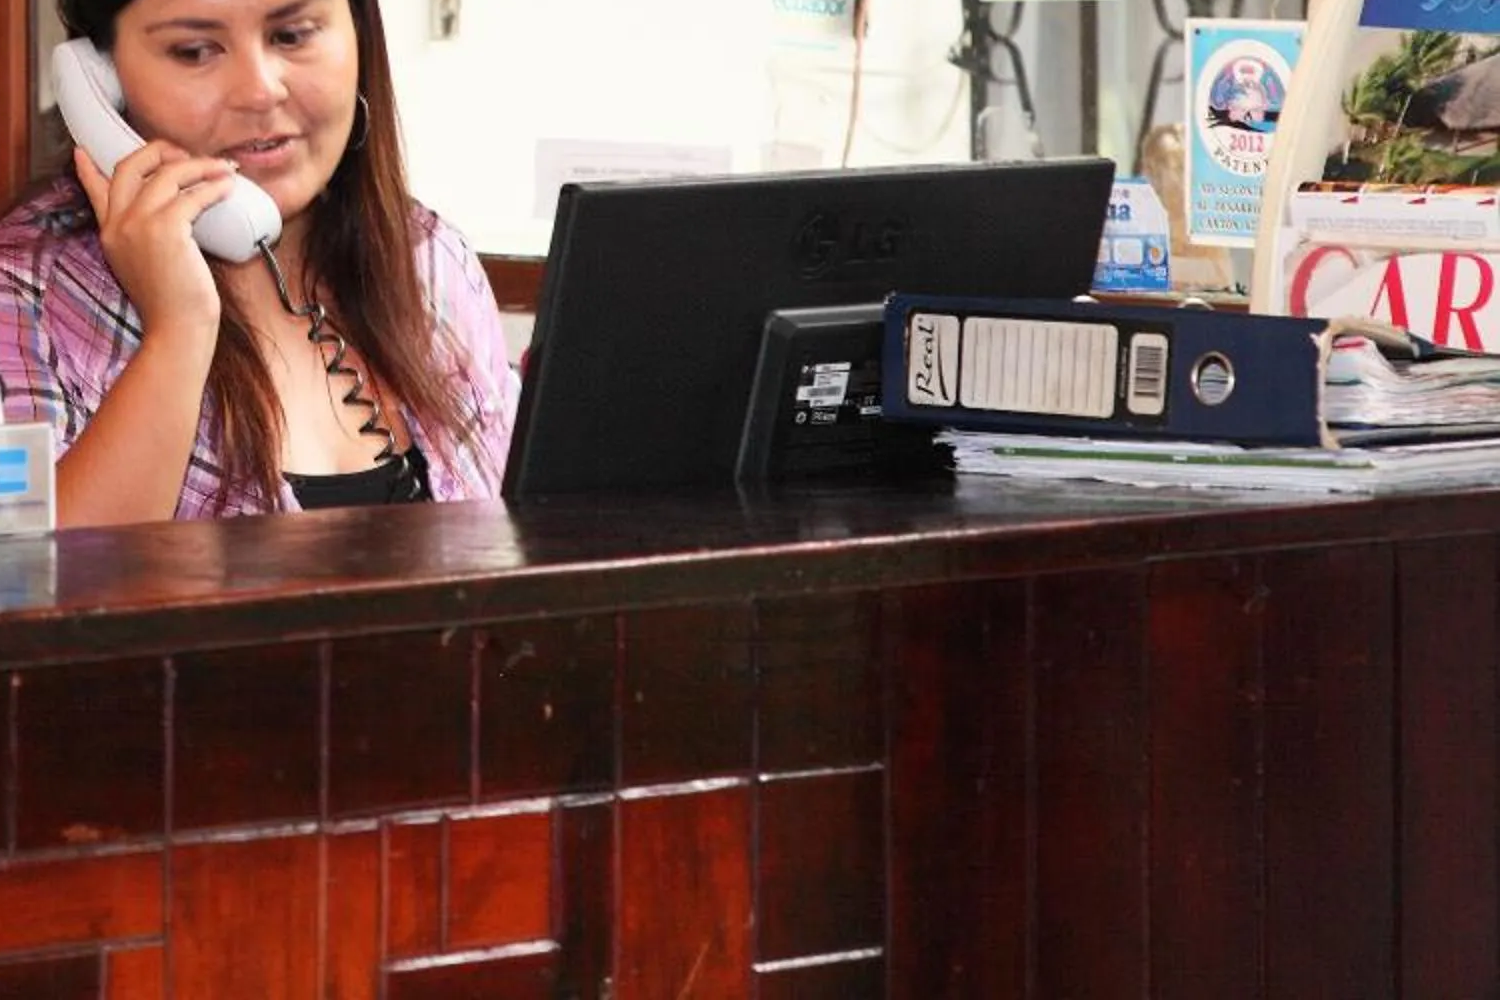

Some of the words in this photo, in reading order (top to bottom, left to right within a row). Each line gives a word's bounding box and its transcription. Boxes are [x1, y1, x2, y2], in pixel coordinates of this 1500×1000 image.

[1230, 134, 1264, 153] 2012
[1290, 245, 1495, 352] CAR
[915, 319, 934, 397] Real
